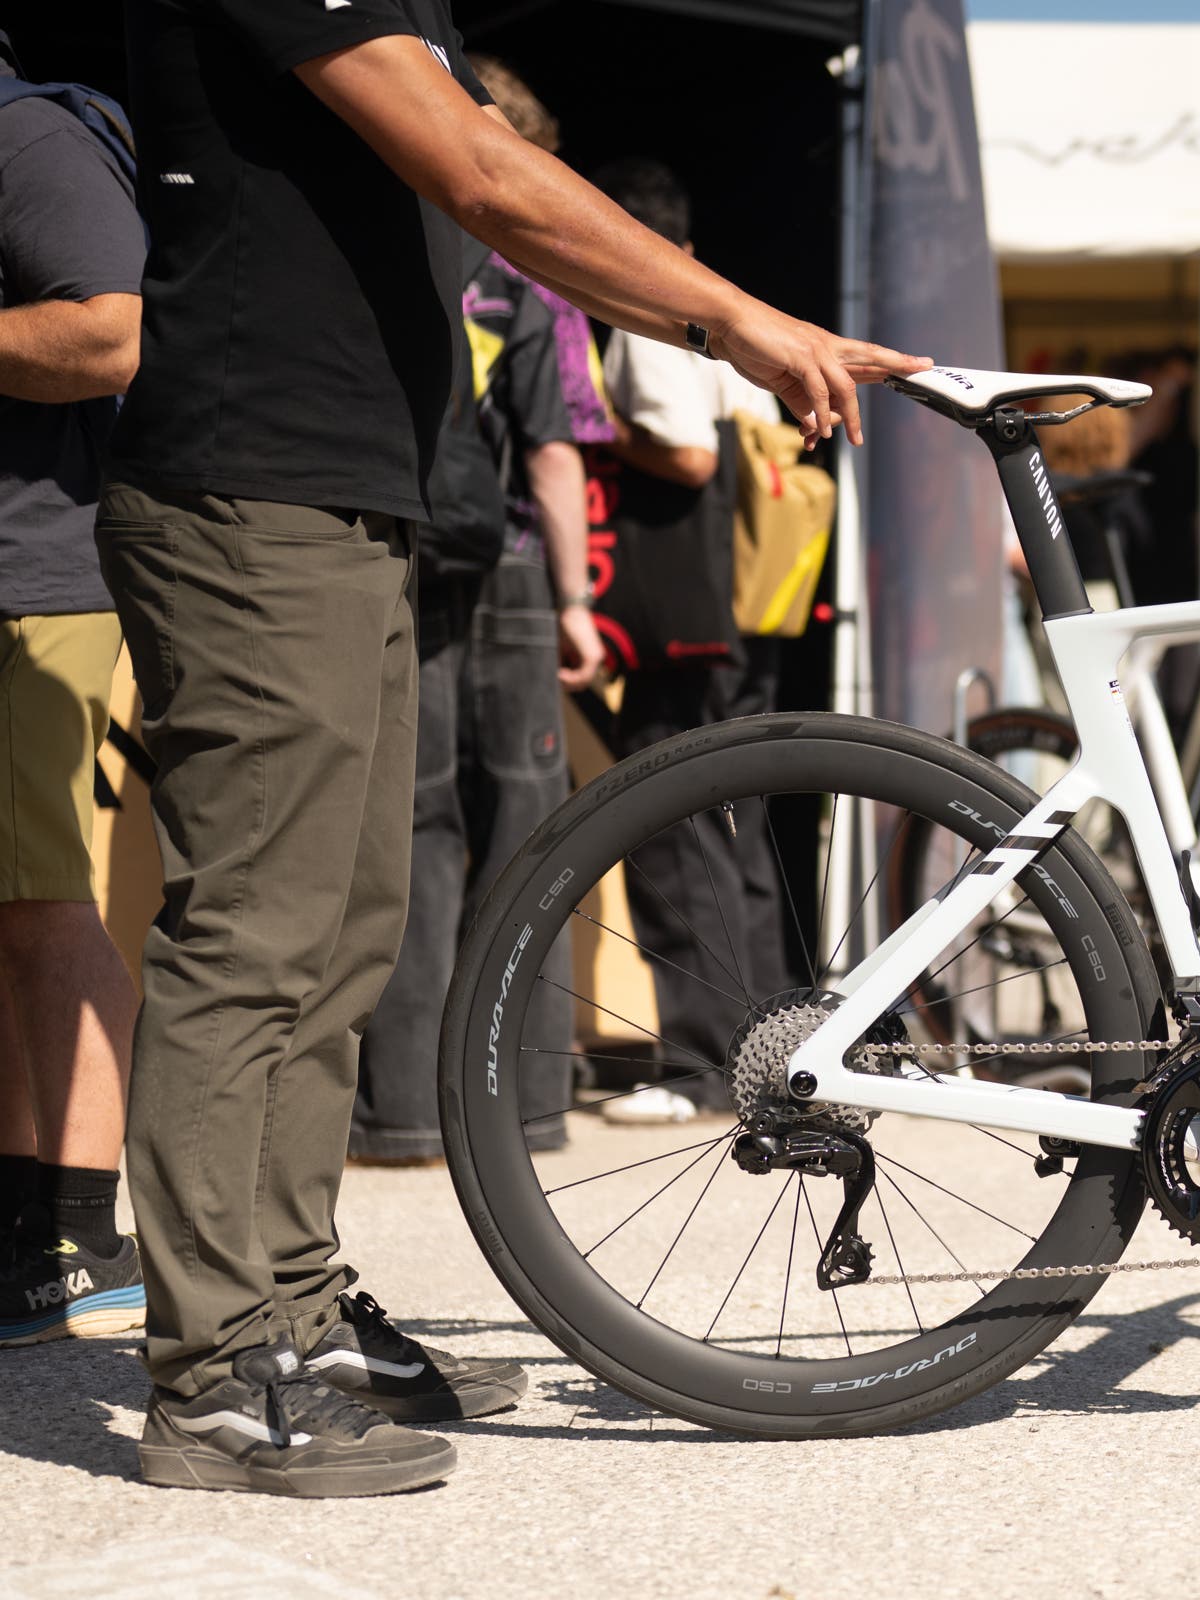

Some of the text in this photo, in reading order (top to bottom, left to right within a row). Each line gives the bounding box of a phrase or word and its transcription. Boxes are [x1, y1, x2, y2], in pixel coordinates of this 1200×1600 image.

[1029, 451, 1062, 540] CANYON
[674, 735, 713, 754] RACE
[948, 800, 1106, 981] DURACE C50
[487, 867, 575, 1096] DURA-ACE C50
[24, 1268, 94, 1310] HOKA
[743, 1332, 977, 1394] DURA-ACE C50
